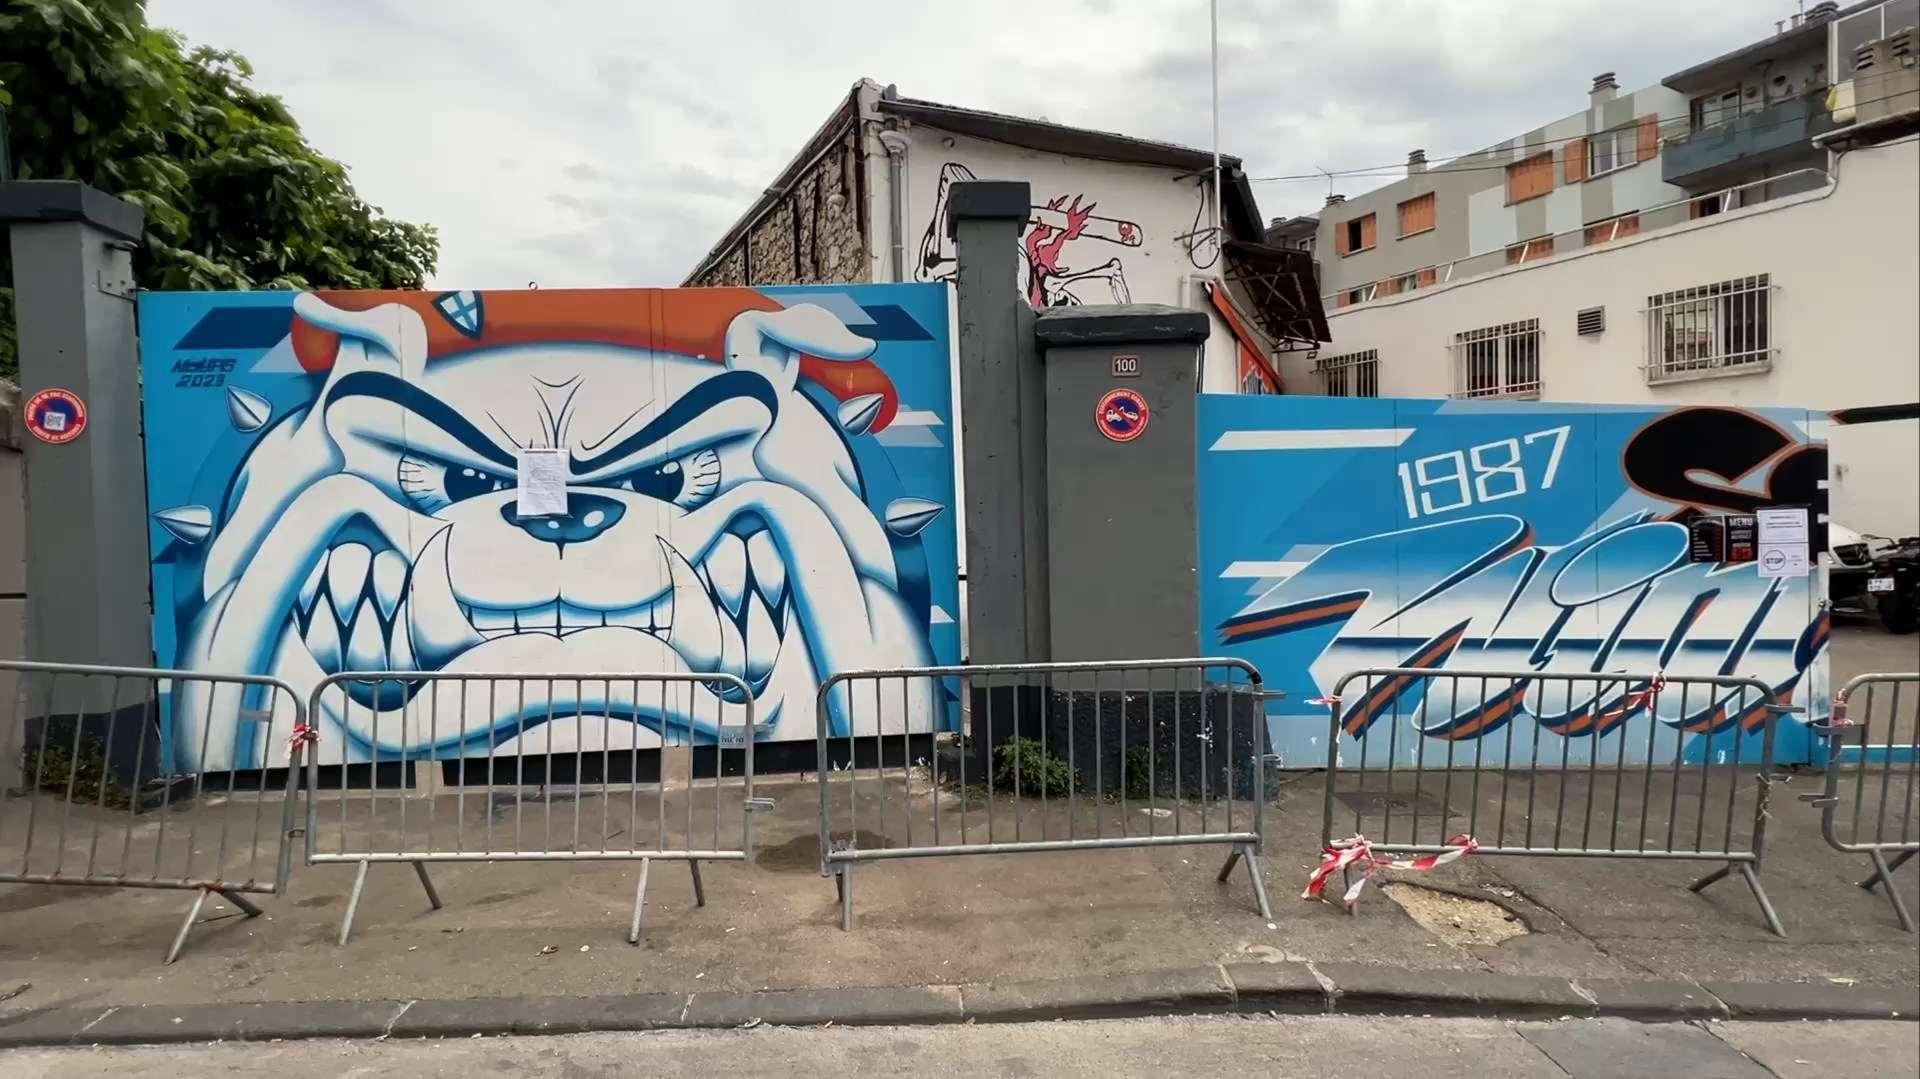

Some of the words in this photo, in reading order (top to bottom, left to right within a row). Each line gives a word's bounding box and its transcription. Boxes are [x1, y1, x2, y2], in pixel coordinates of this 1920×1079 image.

[1115, 358, 1137, 372] 100
[175, 373, 226, 388] 2023
[1398, 425, 1571, 519] 1987
[1729, 517, 1753, 527] MENU
[1766, 557, 1784, 565] STOP
